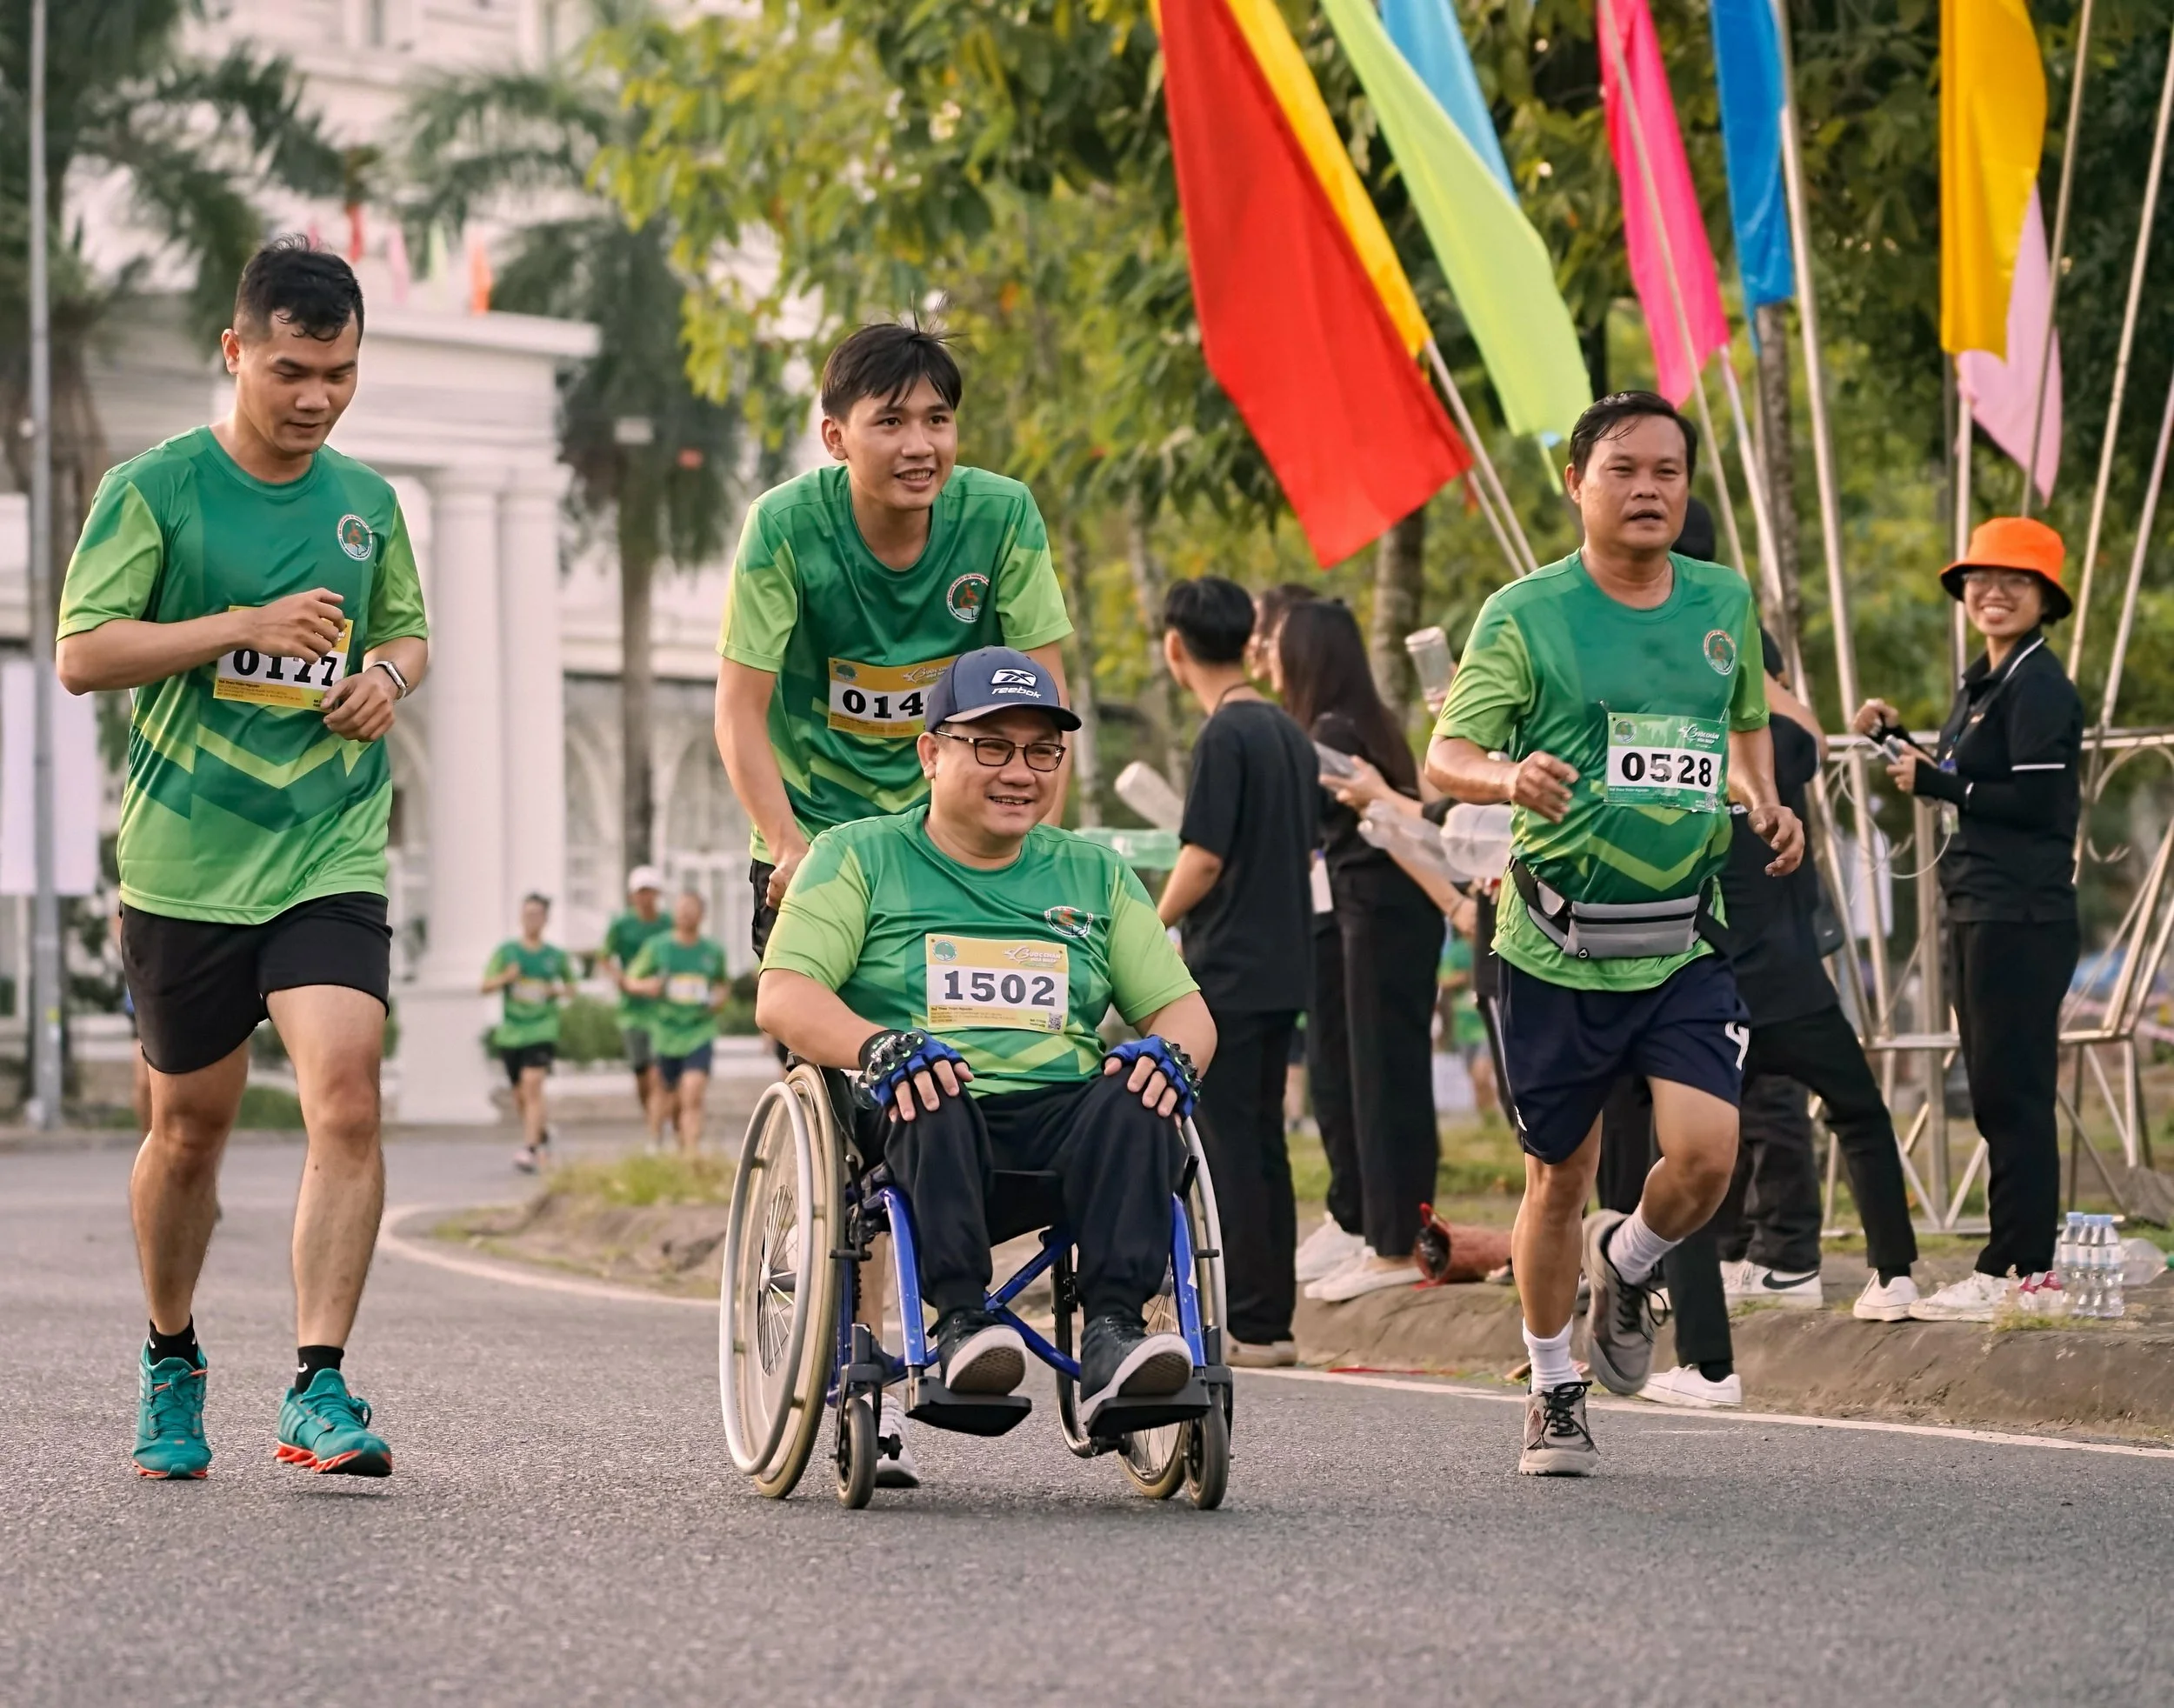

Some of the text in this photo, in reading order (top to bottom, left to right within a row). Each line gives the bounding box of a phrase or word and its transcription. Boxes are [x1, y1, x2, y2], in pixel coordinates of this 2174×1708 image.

[842, 689, 930, 719] 014
[991, 686, 1042, 698] reebok
[1621, 752, 1711, 787] 0528
[944, 970, 1056, 1007] 1502
